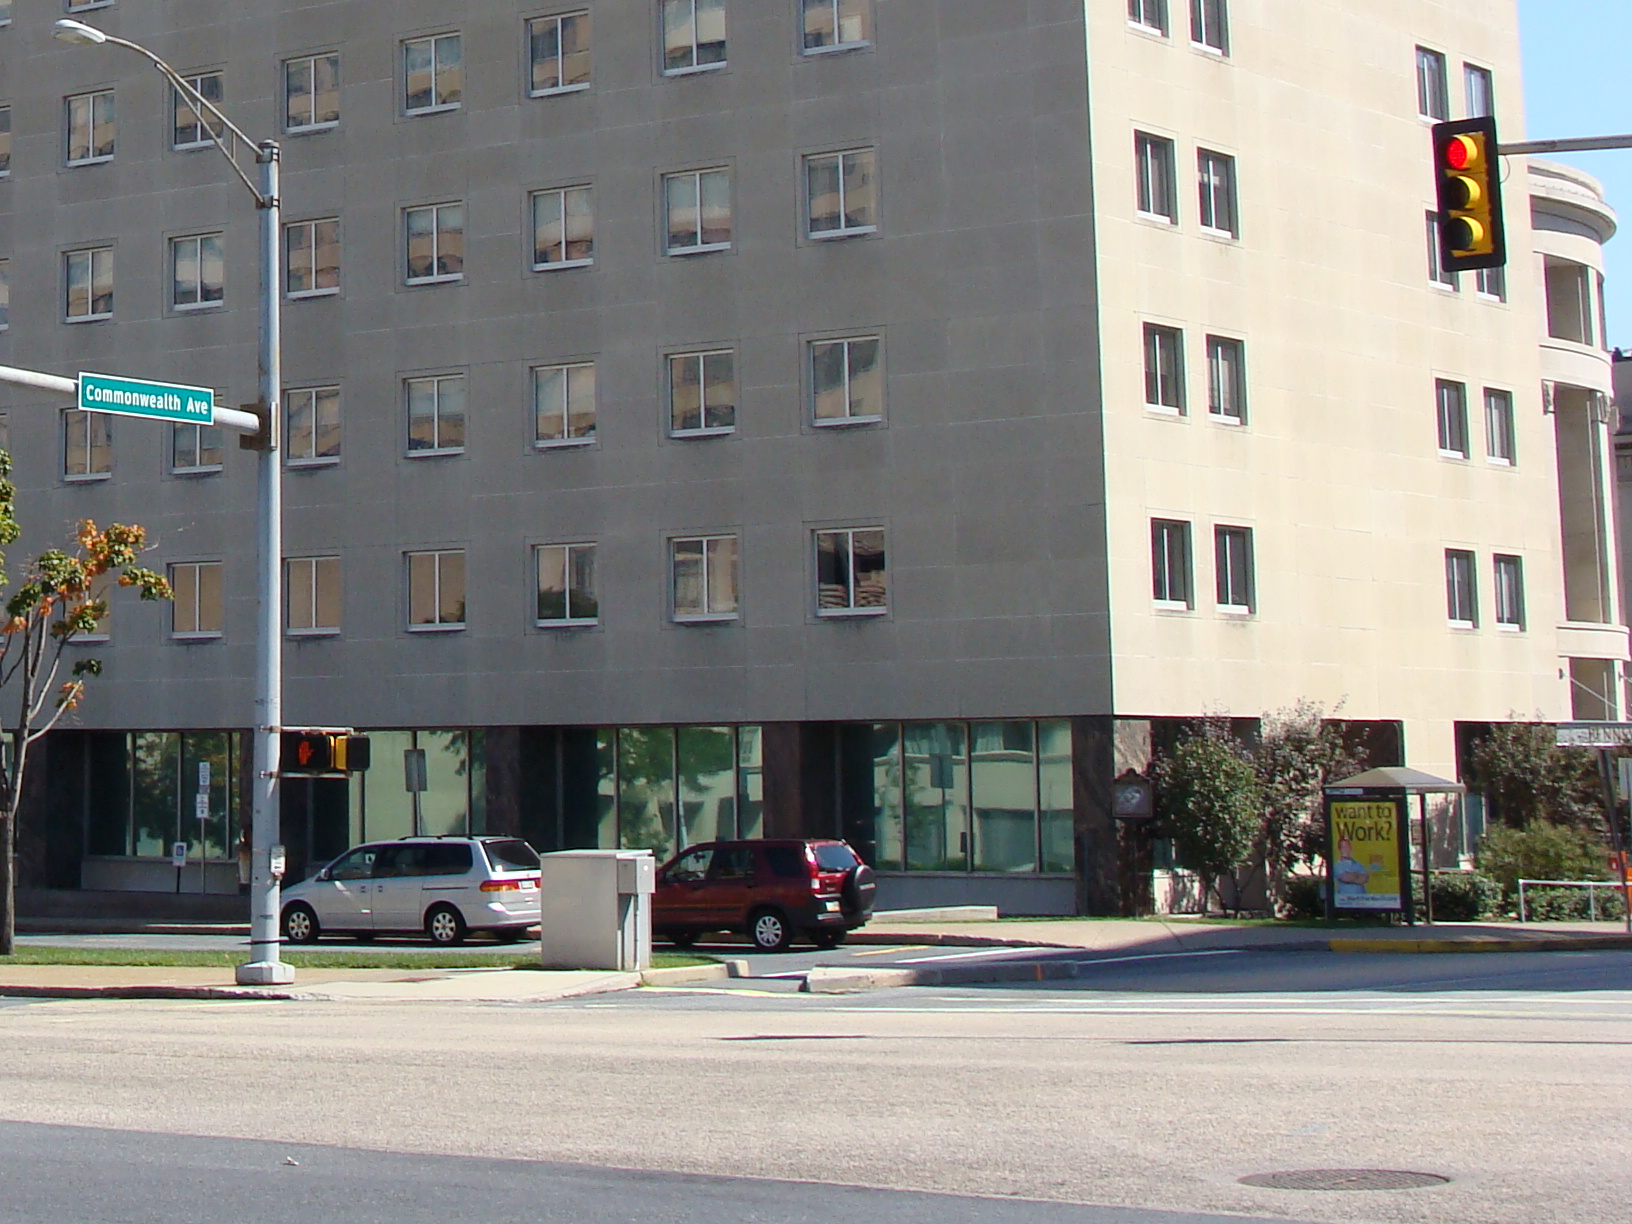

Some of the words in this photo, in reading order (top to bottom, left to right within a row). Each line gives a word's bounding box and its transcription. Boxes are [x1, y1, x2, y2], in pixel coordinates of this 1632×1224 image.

[85, 384, 181, 411] Commonwealth
[186, 396, 208, 415] Ave
[1376, 804, 1392, 819] to
[1336, 821, 1392, 842] Work?
